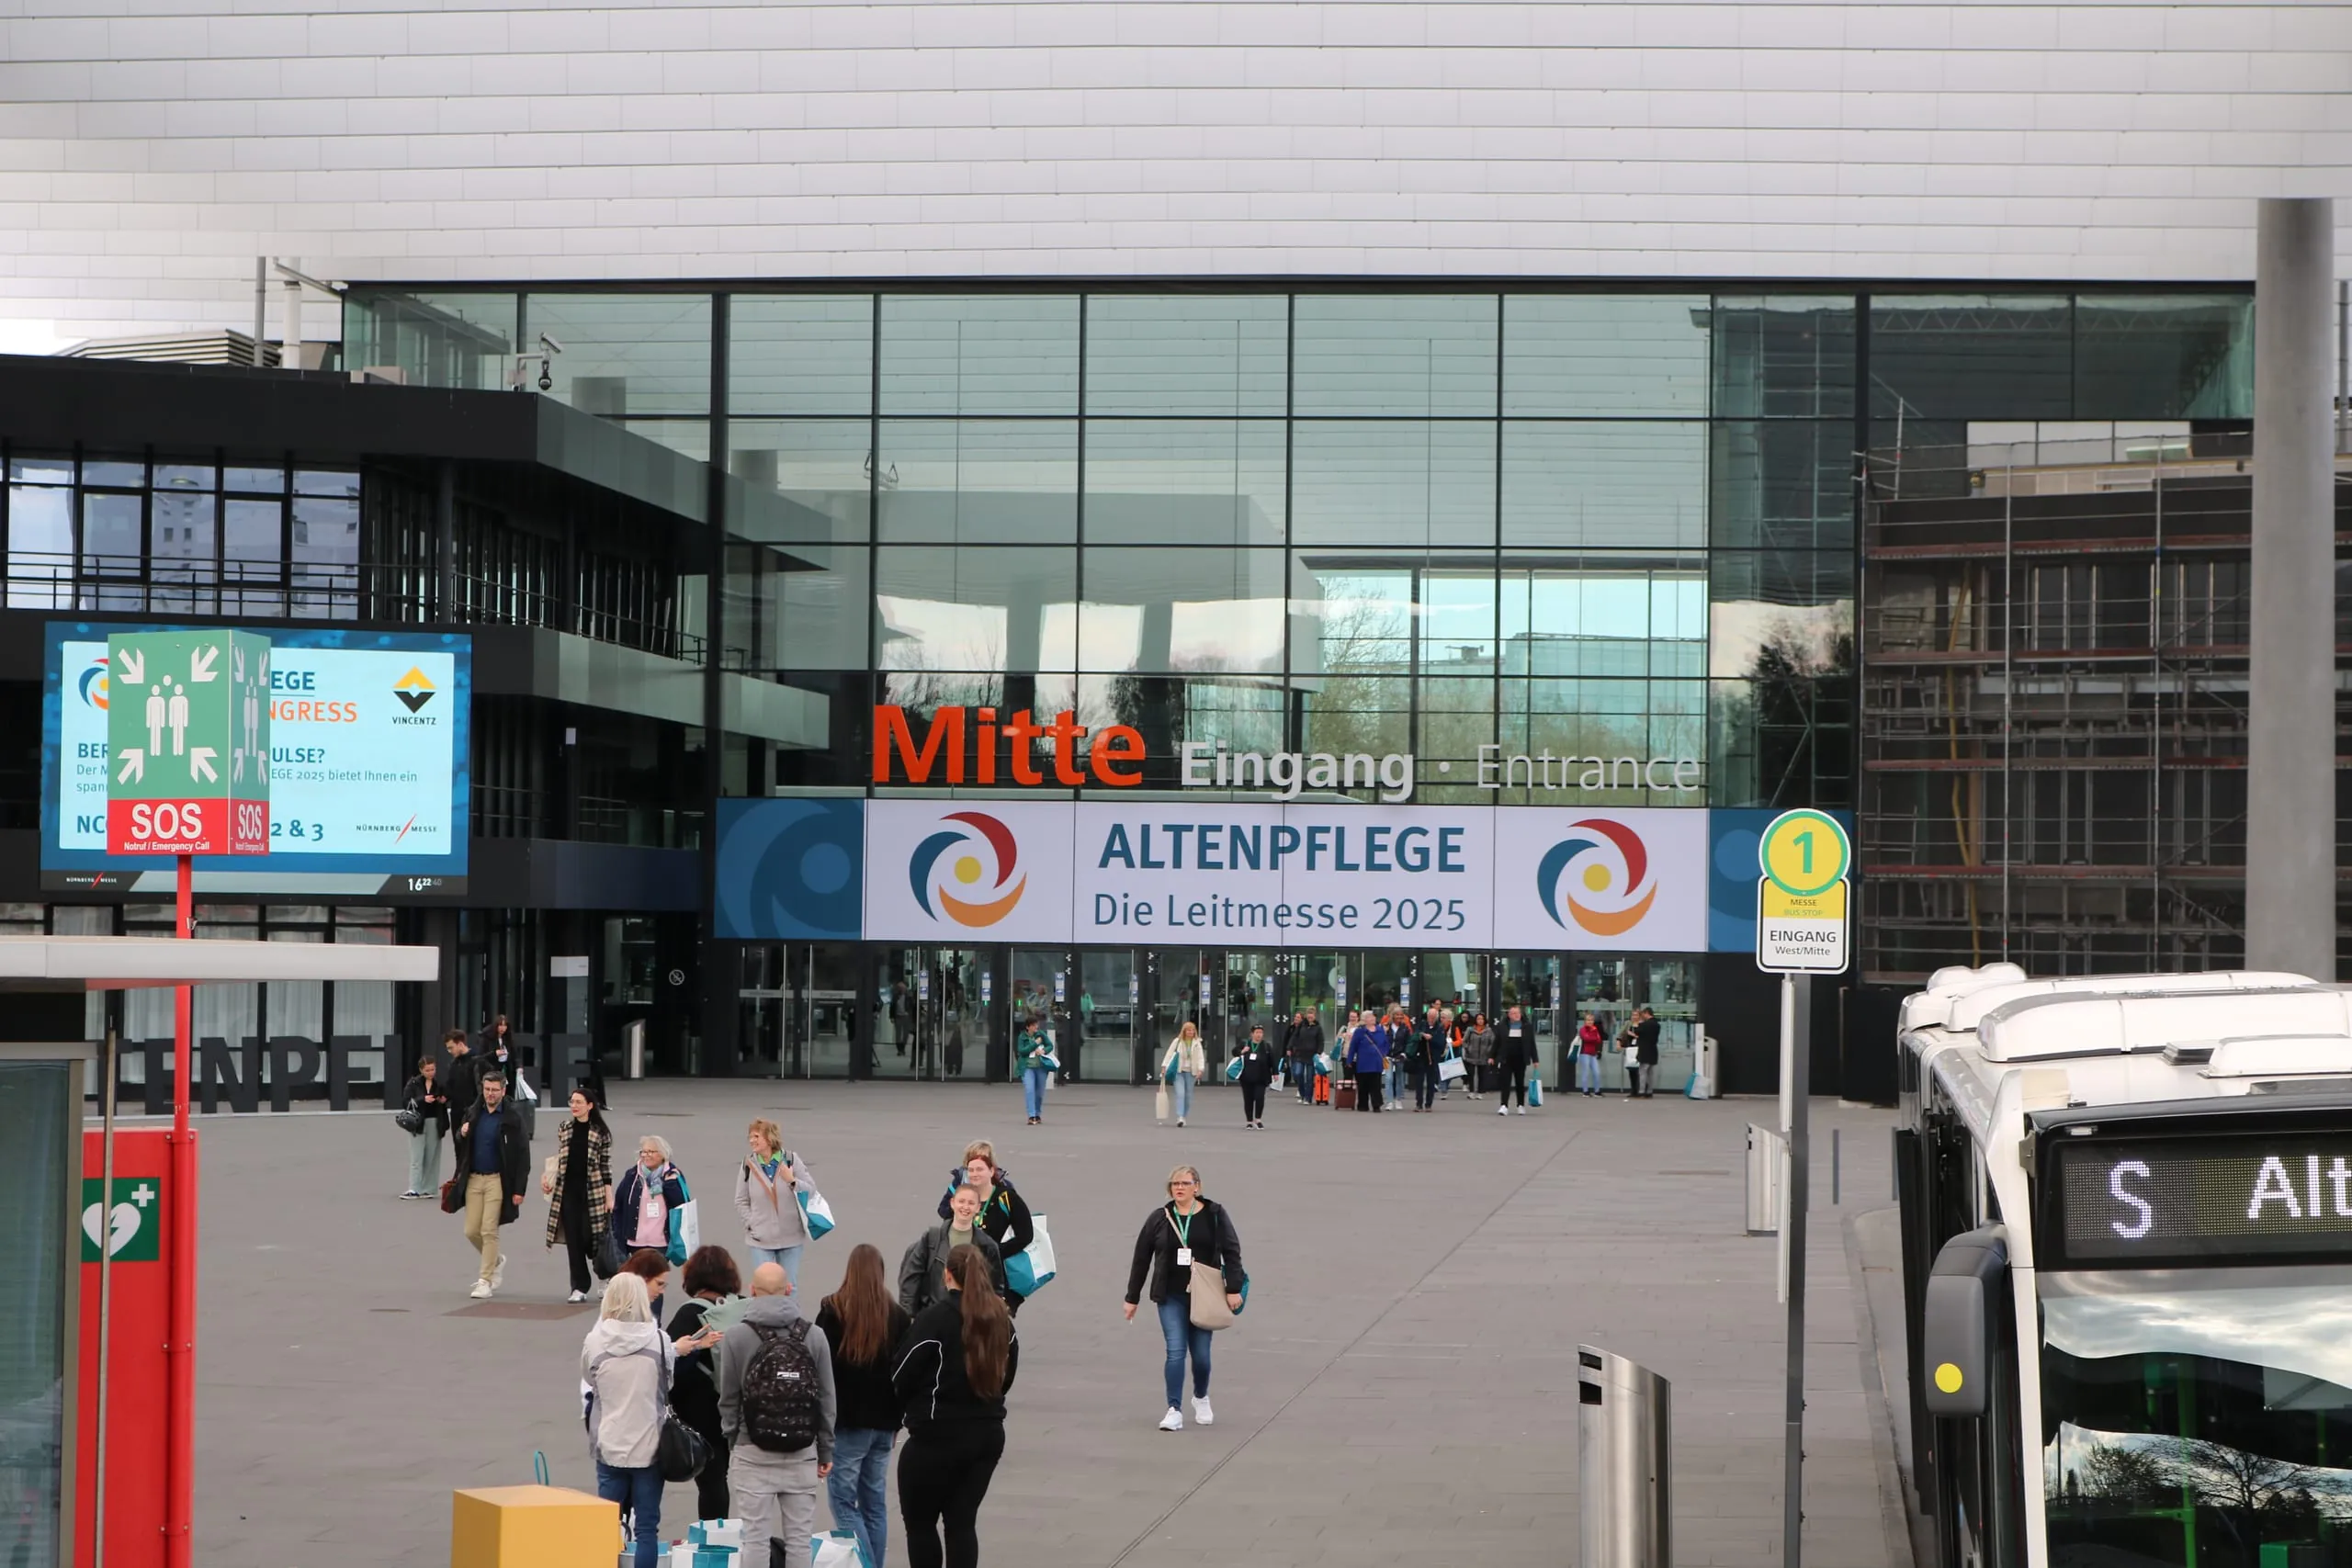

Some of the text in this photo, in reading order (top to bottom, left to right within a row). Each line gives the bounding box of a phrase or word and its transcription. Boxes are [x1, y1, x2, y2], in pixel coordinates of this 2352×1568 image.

[392, 716, 437, 725] VINCENTZ
[872, 704, 1147, 786] Mitte
[1181, 740, 1415, 803] Eingang
[1476, 743, 1701, 792] Entrance
[76, 763, 97, 775] Der
[296, 772, 325, 782] 2025
[328, 769, 361, 781] bietet
[364, 770, 398, 782] Ihnen
[400, 772, 418, 782] ein
[76, 783, 108, 795] span
[77, 815, 108, 833] NC
[130, 802, 203, 840] SOS
[238, 804, 262, 840] SOS
[356, 824, 401, 832] NÜRNBERG
[270, 819, 323, 841] 2 & 3
[124, 841, 147, 851] Notruf
[152, 841, 193, 852] Emergency
[195, 841, 209, 850] Call
[1098, 823, 1465, 874] ALTENPFLEGE
[1792, 831, 1814, 874] 1
[1790, 898, 1817, 907] MESSE
[1094, 893, 1465, 931] Die Leitmesse 2025
[1770, 930, 1837, 942] EINGANG
[1775, 945, 1831, 956] West/Mitte
[2109, 1155, 2352, 1238] S Alt
